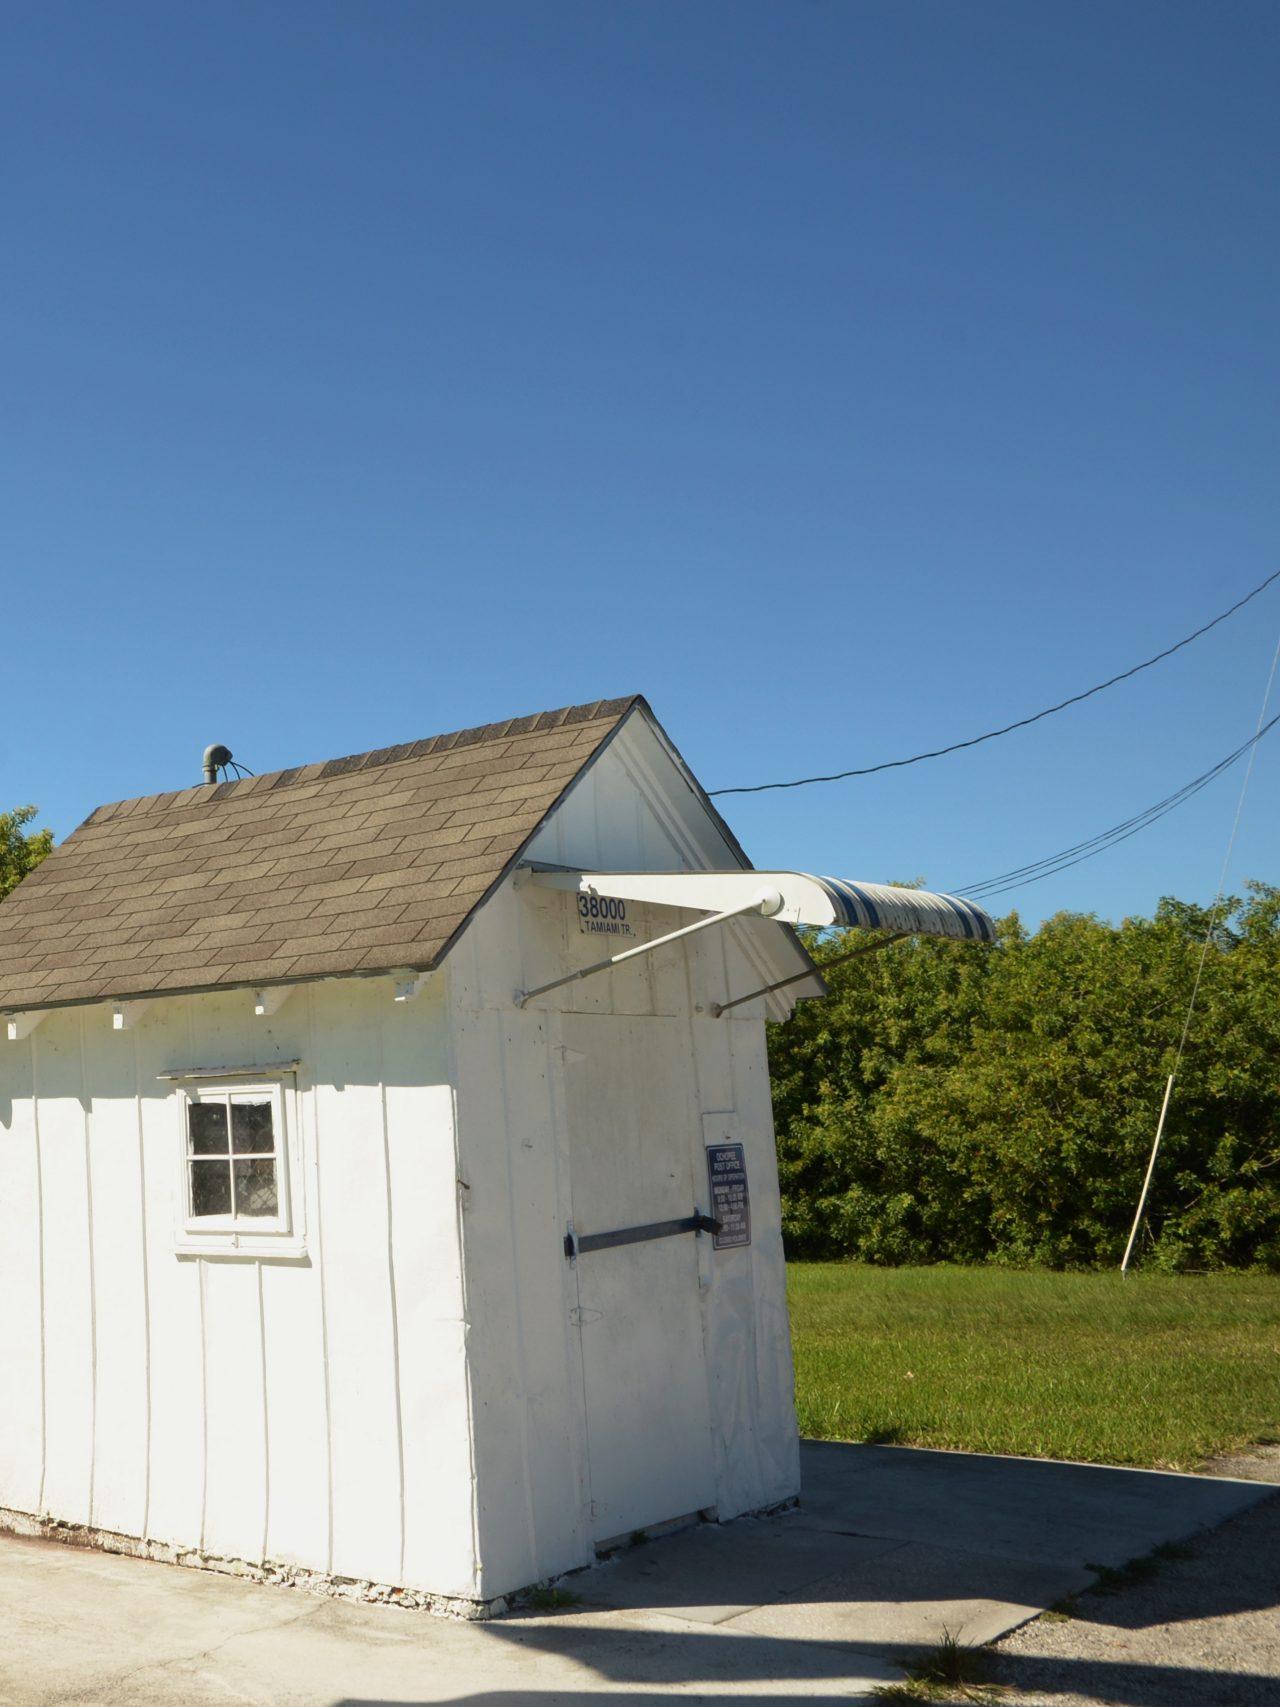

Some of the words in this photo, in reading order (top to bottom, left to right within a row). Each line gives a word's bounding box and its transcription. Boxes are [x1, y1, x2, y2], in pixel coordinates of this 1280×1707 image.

[579, 895, 626, 920] 38000
[585, 921, 620, 934] TAMIAMI
[713, 1162, 725, 1171] POST
[726, 1160, 740, 1170] OFFICE
